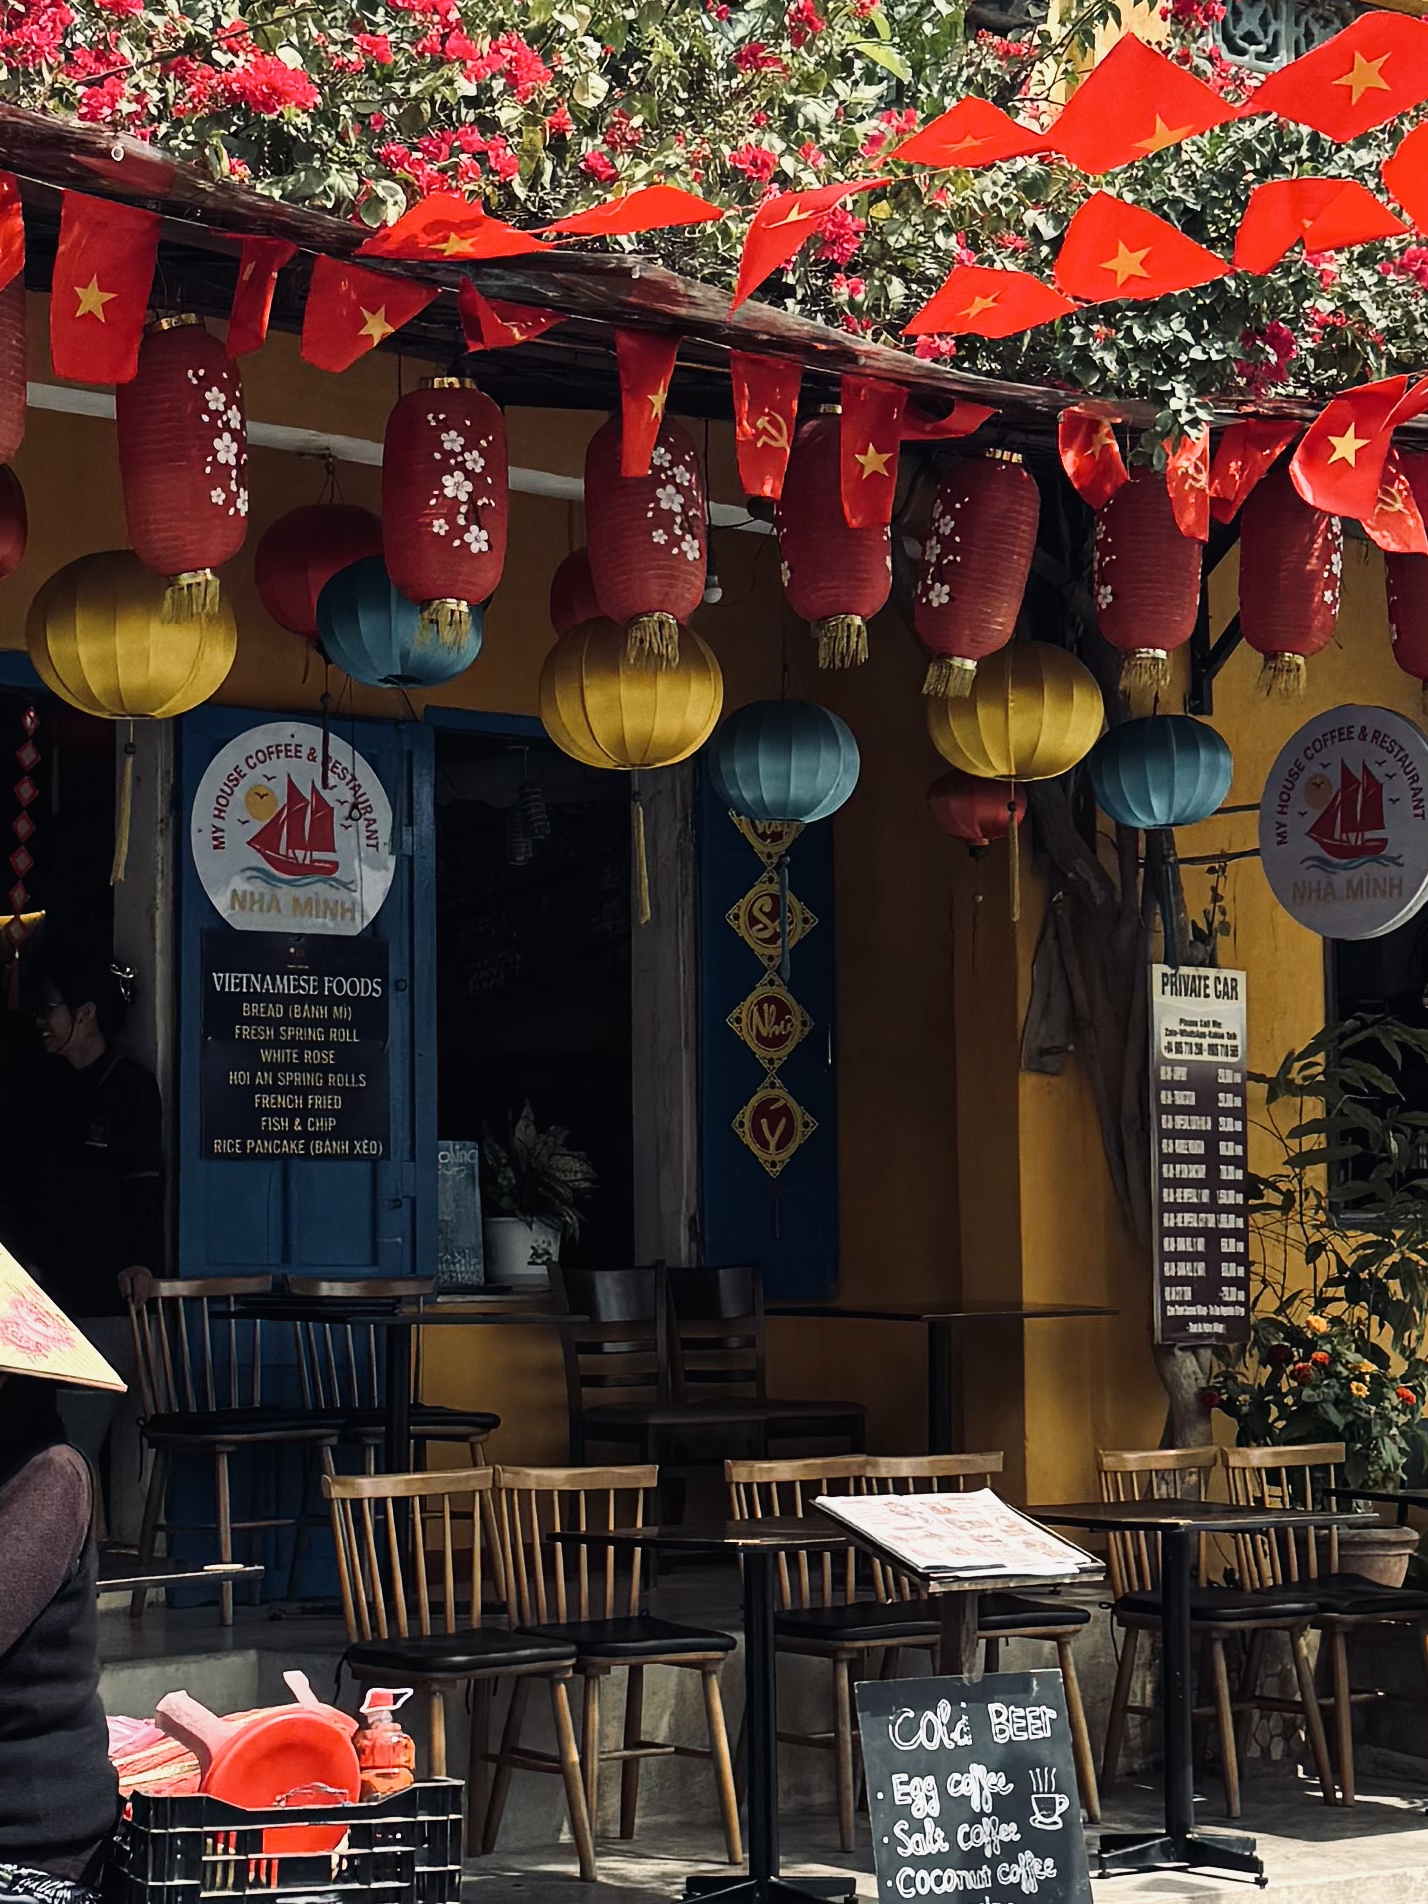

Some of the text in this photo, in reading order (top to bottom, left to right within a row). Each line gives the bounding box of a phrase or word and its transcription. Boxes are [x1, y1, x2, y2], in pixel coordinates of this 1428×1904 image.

[244, 743, 304, 771] COFFEE
[306, 746, 318, 764] &
[212, 764, 247, 821] HOUSE
[1275, 724, 1426, 847] MY HOUSE COFFEE & RESTAURANT
[211, 824, 227, 852] MY
[212, 971, 383, 998] VIETNAMESE FOODS
[1161, 972, 1239, 1001] PRIVATE CAR
[242, 1002, 284, 1018] BREAD
[234, 1024, 361, 1043] FRESH SPRING ROLL
[260, 1048, 336, 1065] WHITE ROSE
[229, 1070, 367, 1088] HOI AN SPRING ROLLS
[254, 1093, 343, 1110] FRENCH FRIED
[260, 1116, 337, 1132] FISH & CHIP
[213, 1138, 243, 1155] RICE
[246, 1138, 306, 1155] PANCAKE
[891, 1772, 941, 1819] Egg
[893, 1817, 950, 1858] Salt
[895, 1864, 992, 1899] Coconut
